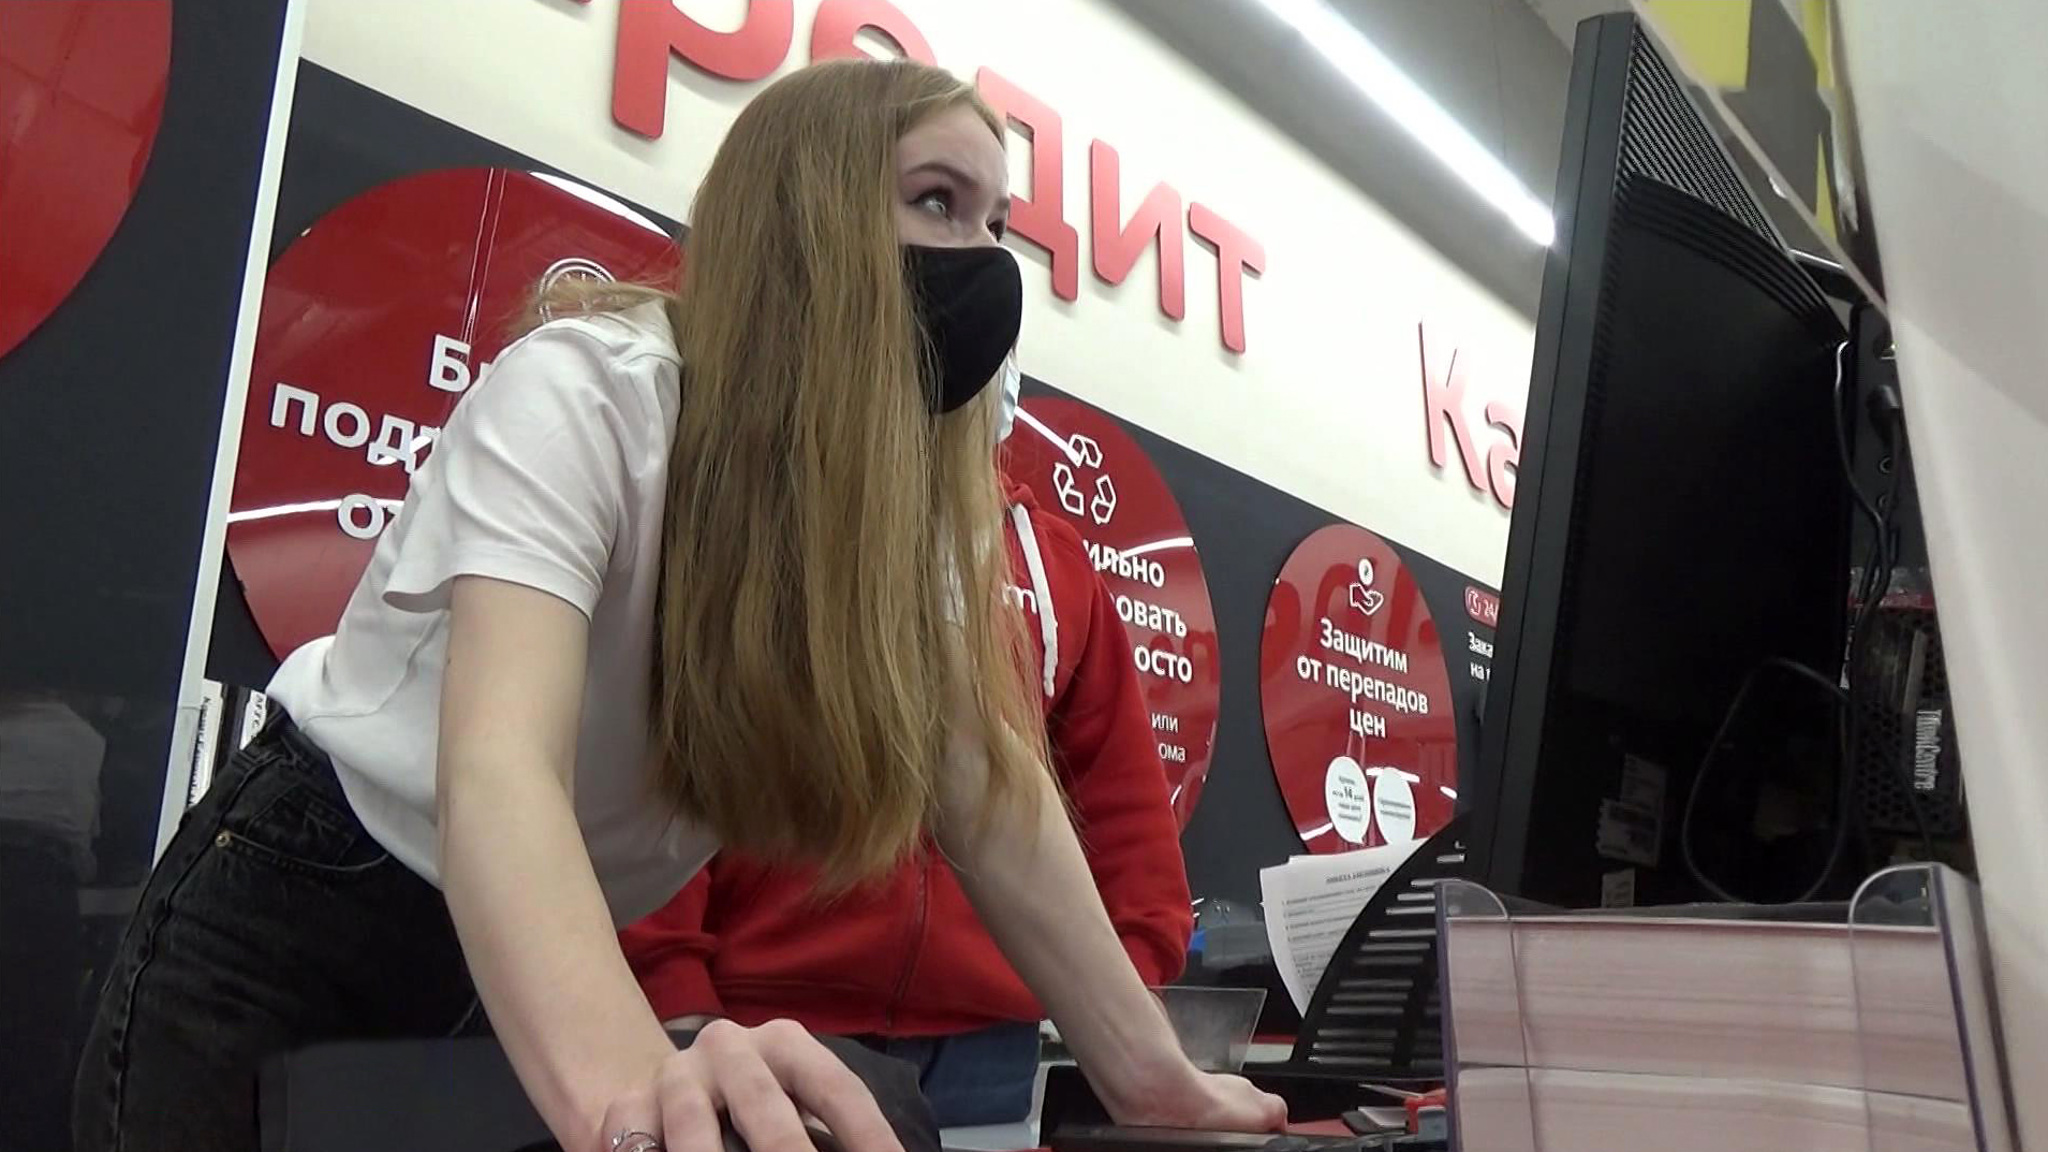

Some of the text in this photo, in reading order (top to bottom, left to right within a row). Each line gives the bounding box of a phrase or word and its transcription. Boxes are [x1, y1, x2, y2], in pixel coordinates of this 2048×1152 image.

[429, 334, 492, 392] Б
[1320, 617, 1408, 674] Защитим
[1297, 655, 1428, 714] от перепадов
[1151, 713, 1178, 733] или
[1350, 708, 1386, 739] цен
